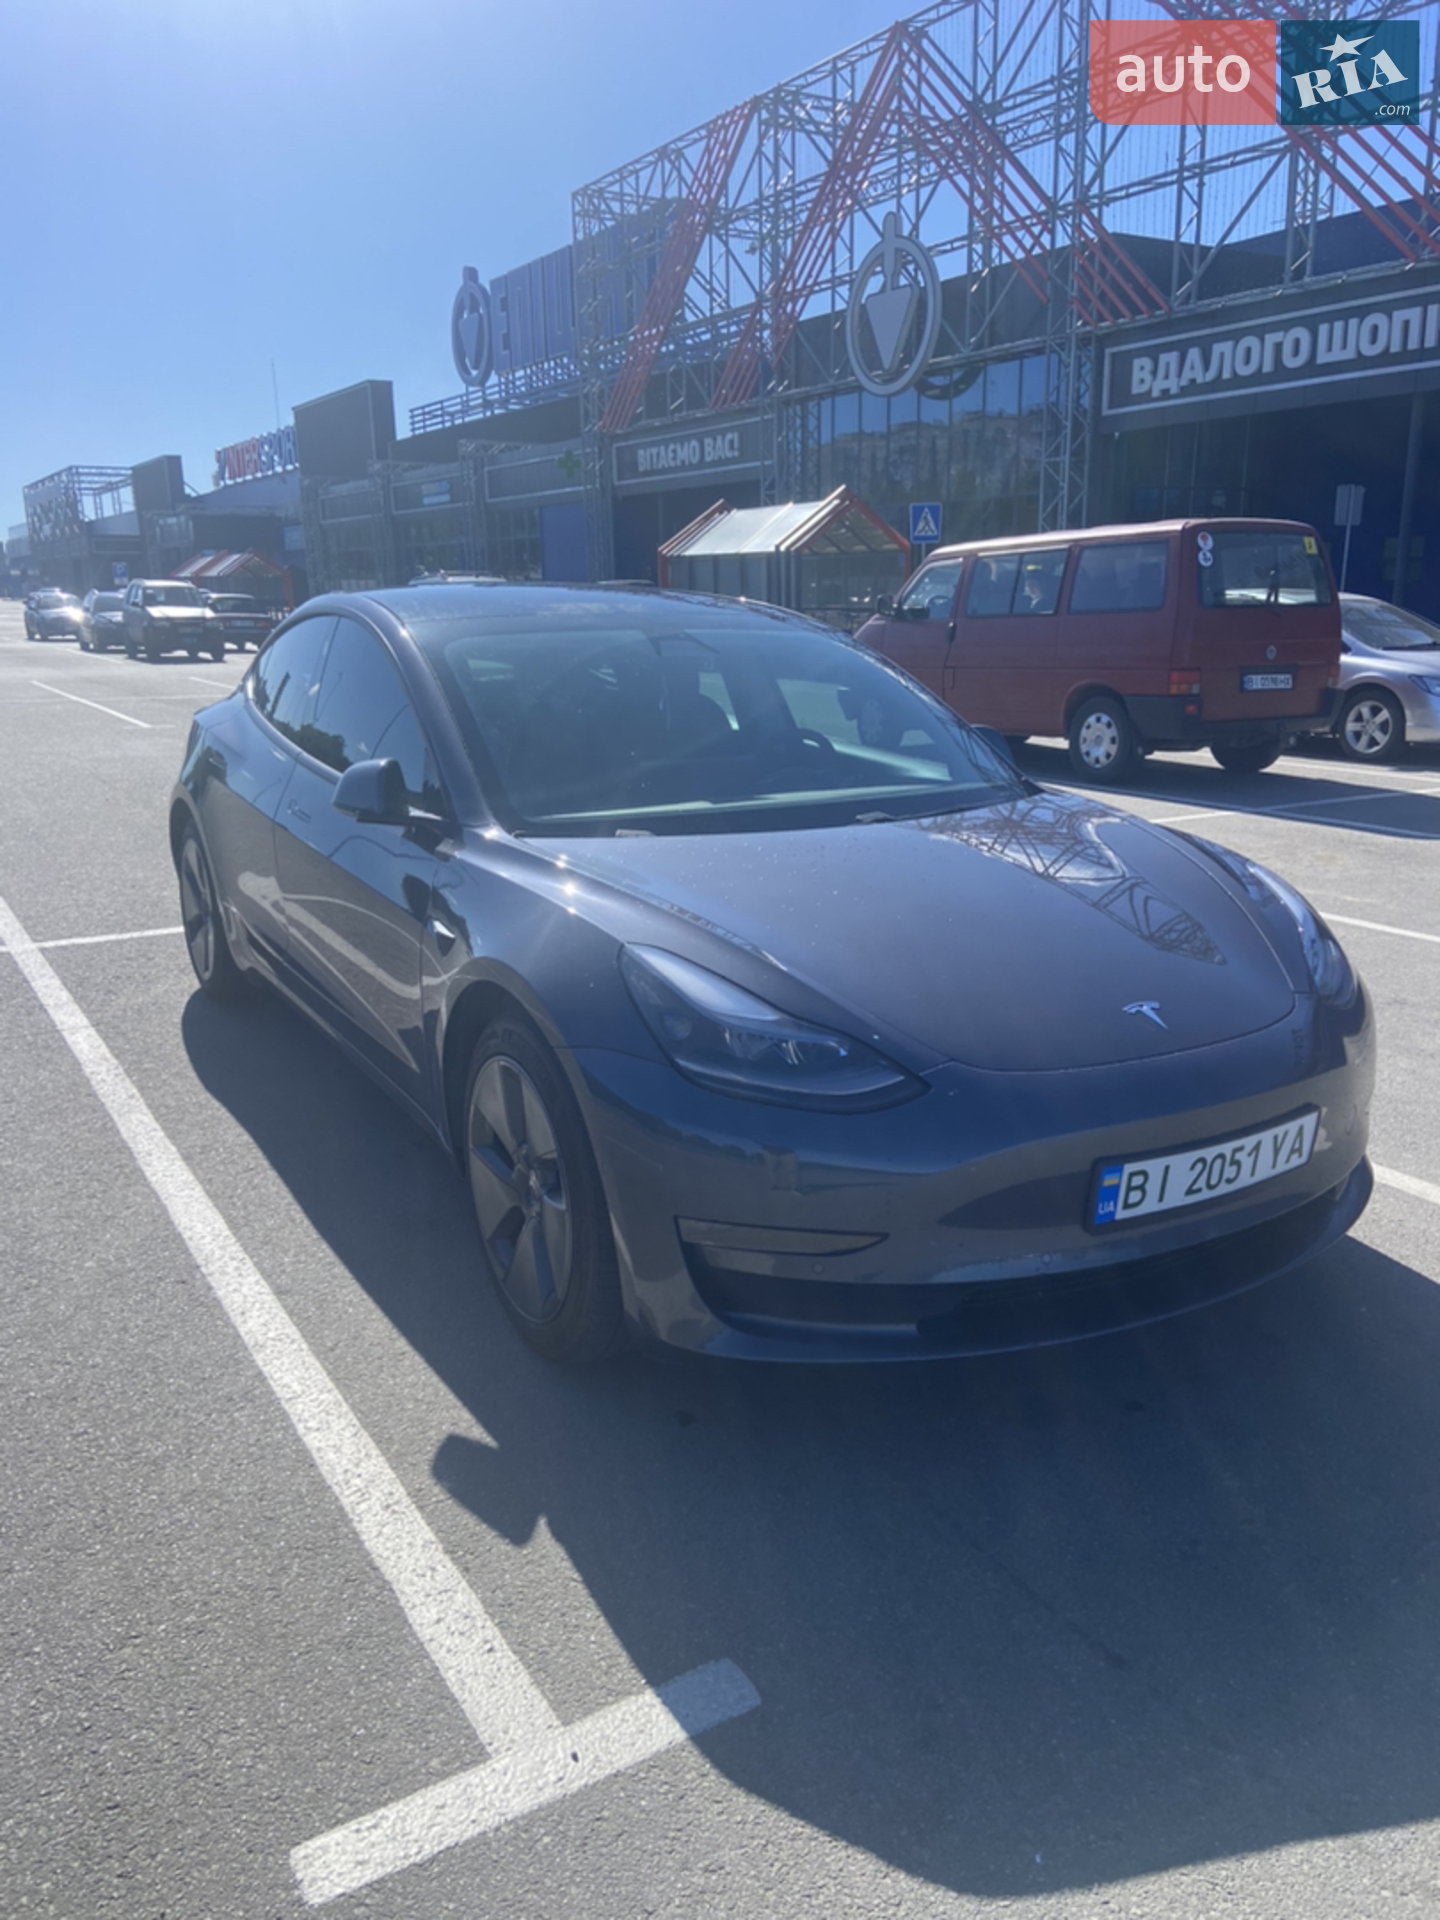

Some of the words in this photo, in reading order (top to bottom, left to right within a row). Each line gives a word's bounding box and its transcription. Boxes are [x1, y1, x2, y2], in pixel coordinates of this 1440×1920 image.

[1131, 327, 1313, 398] ВДАЛОГО
[637, 439, 700, 472] ВІТАЄМО
[703, 432, 740, 463] ВАС!
[1121, 1164, 1170, 1210] BI
[1184, 1139, 1262, 1196] 2051
[1271, 1124, 1305, 1170] YA
[1098, 1200, 1115, 1215] UA
